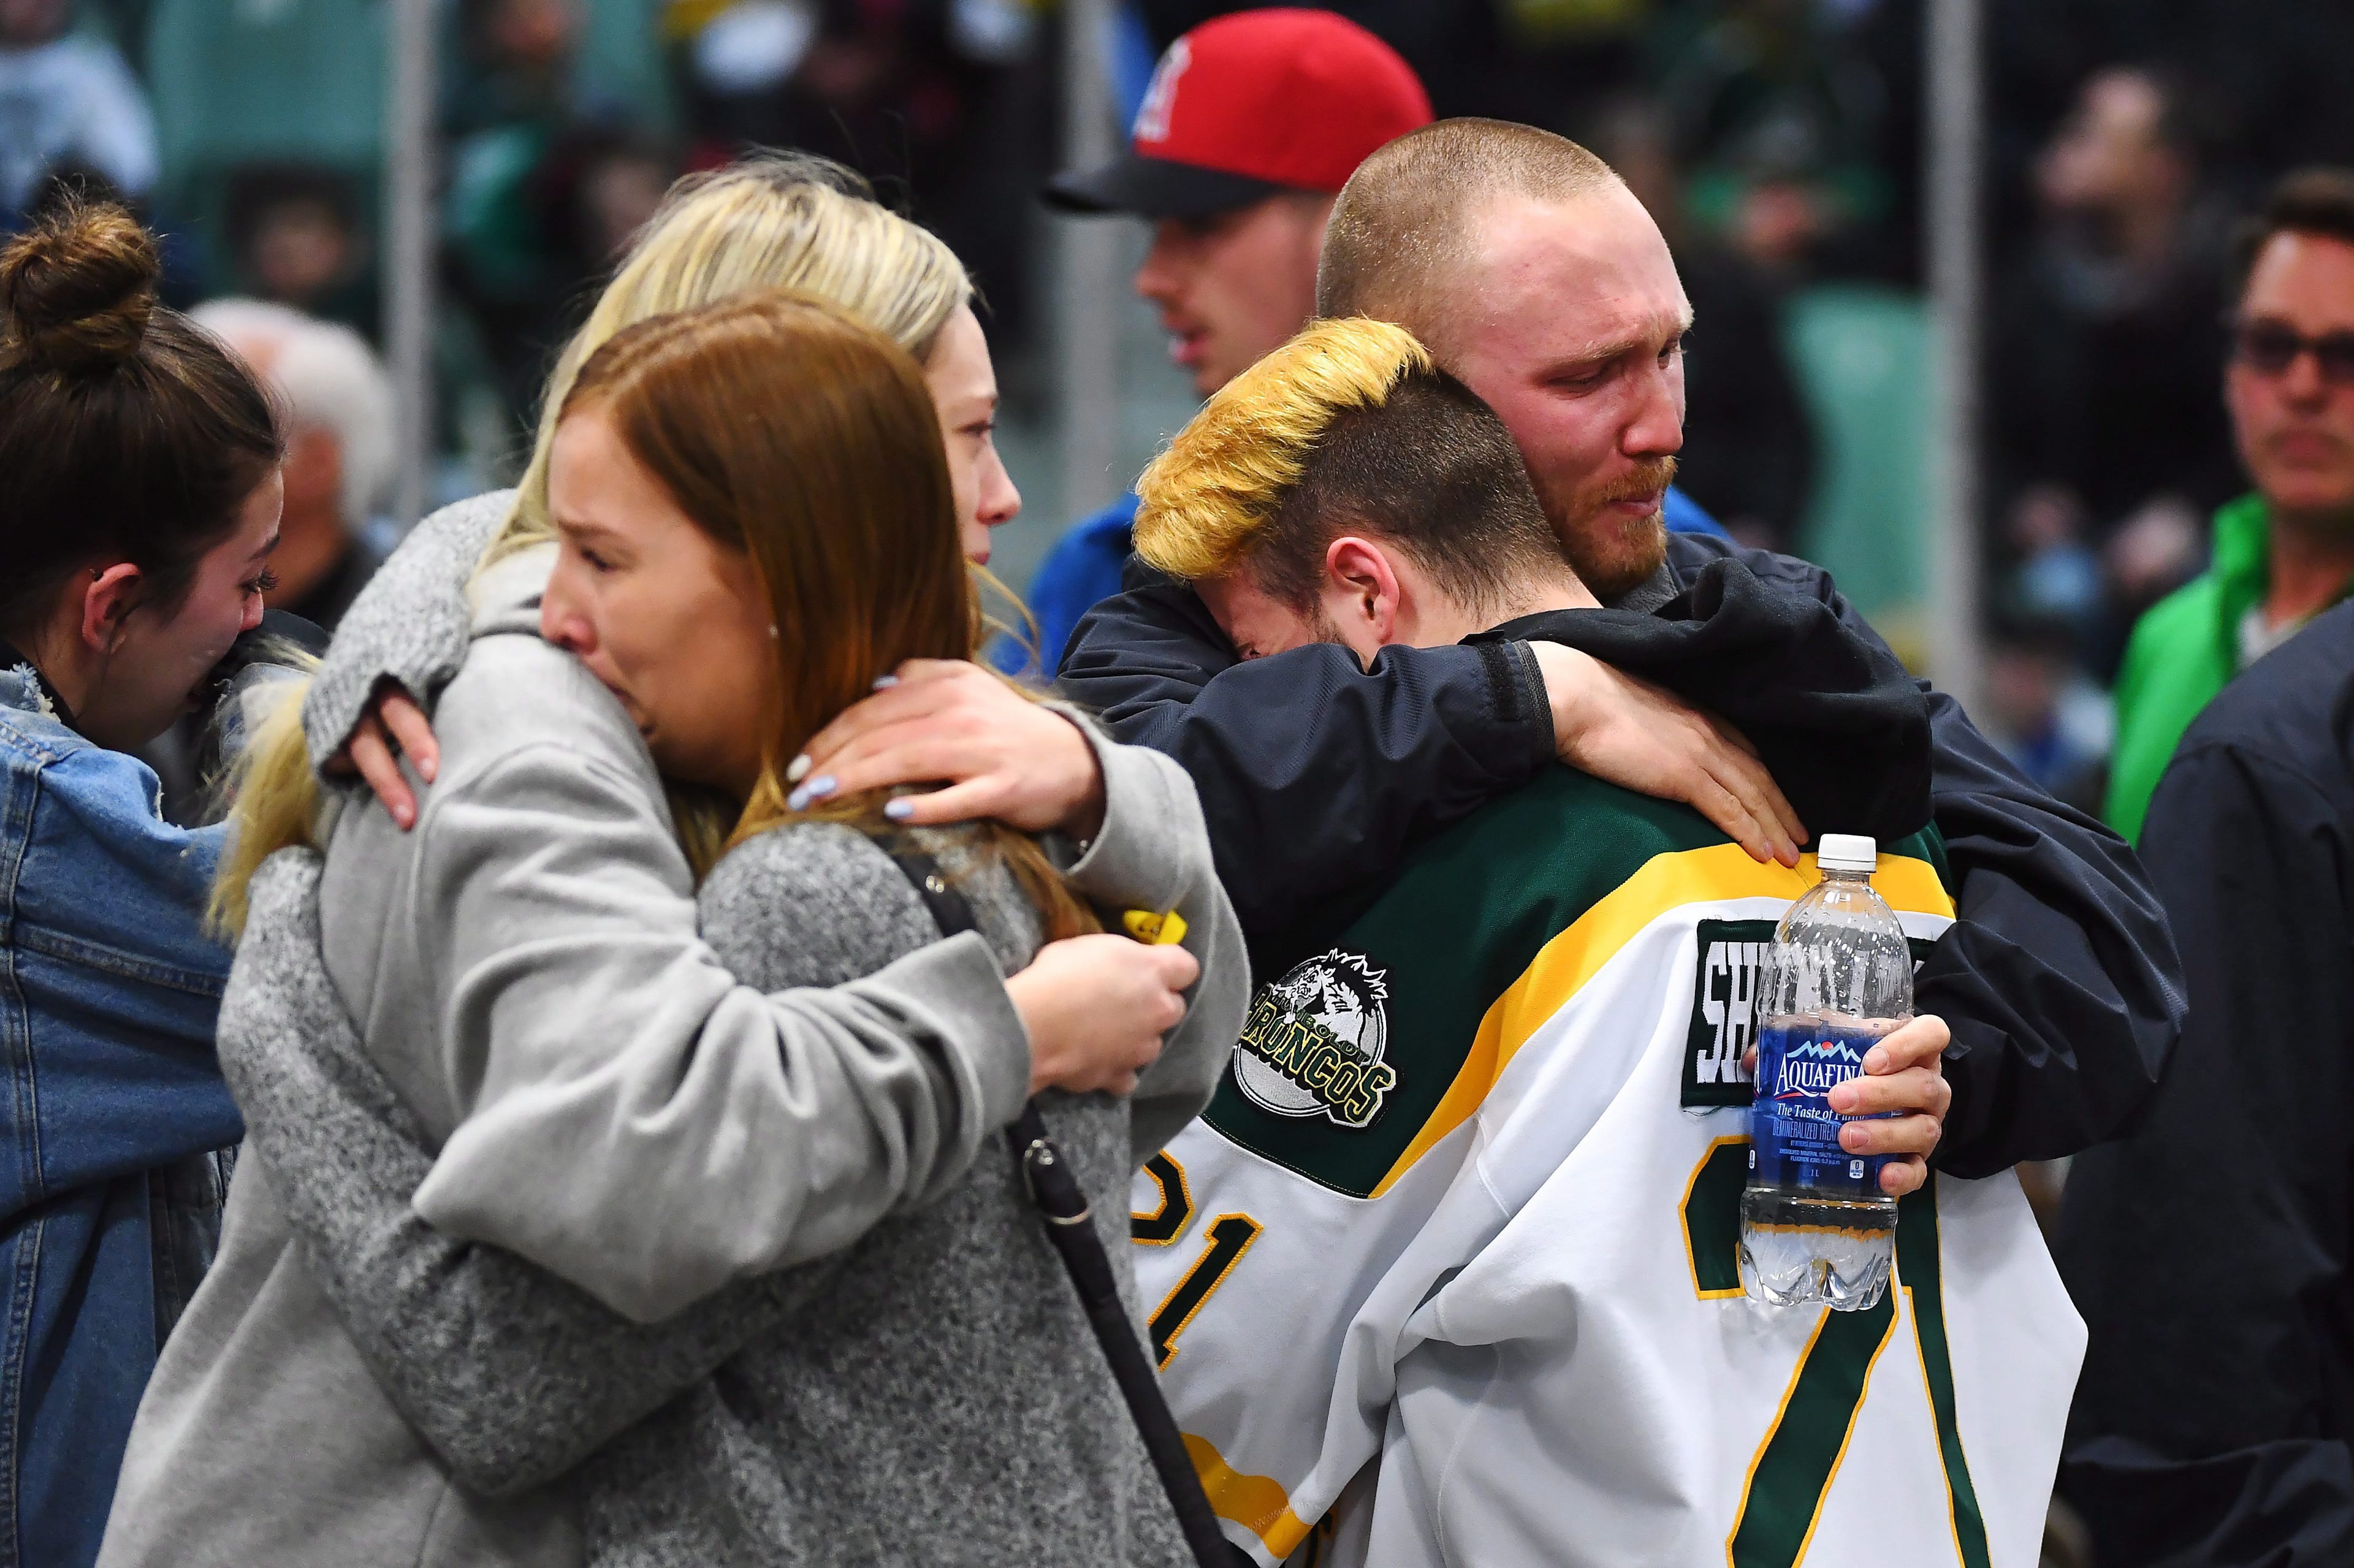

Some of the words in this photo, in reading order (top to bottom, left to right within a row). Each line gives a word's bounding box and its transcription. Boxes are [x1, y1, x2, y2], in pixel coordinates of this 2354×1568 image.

[1777, 1103, 1792, 1116] The
[1794, 1105, 1819, 1119] Taste
[1822, 1108, 1834, 1123] of
[1772, 1119, 1818, 1140] DEMINERALIZED
[1819, 1123, 1840, 1141] TREAT
